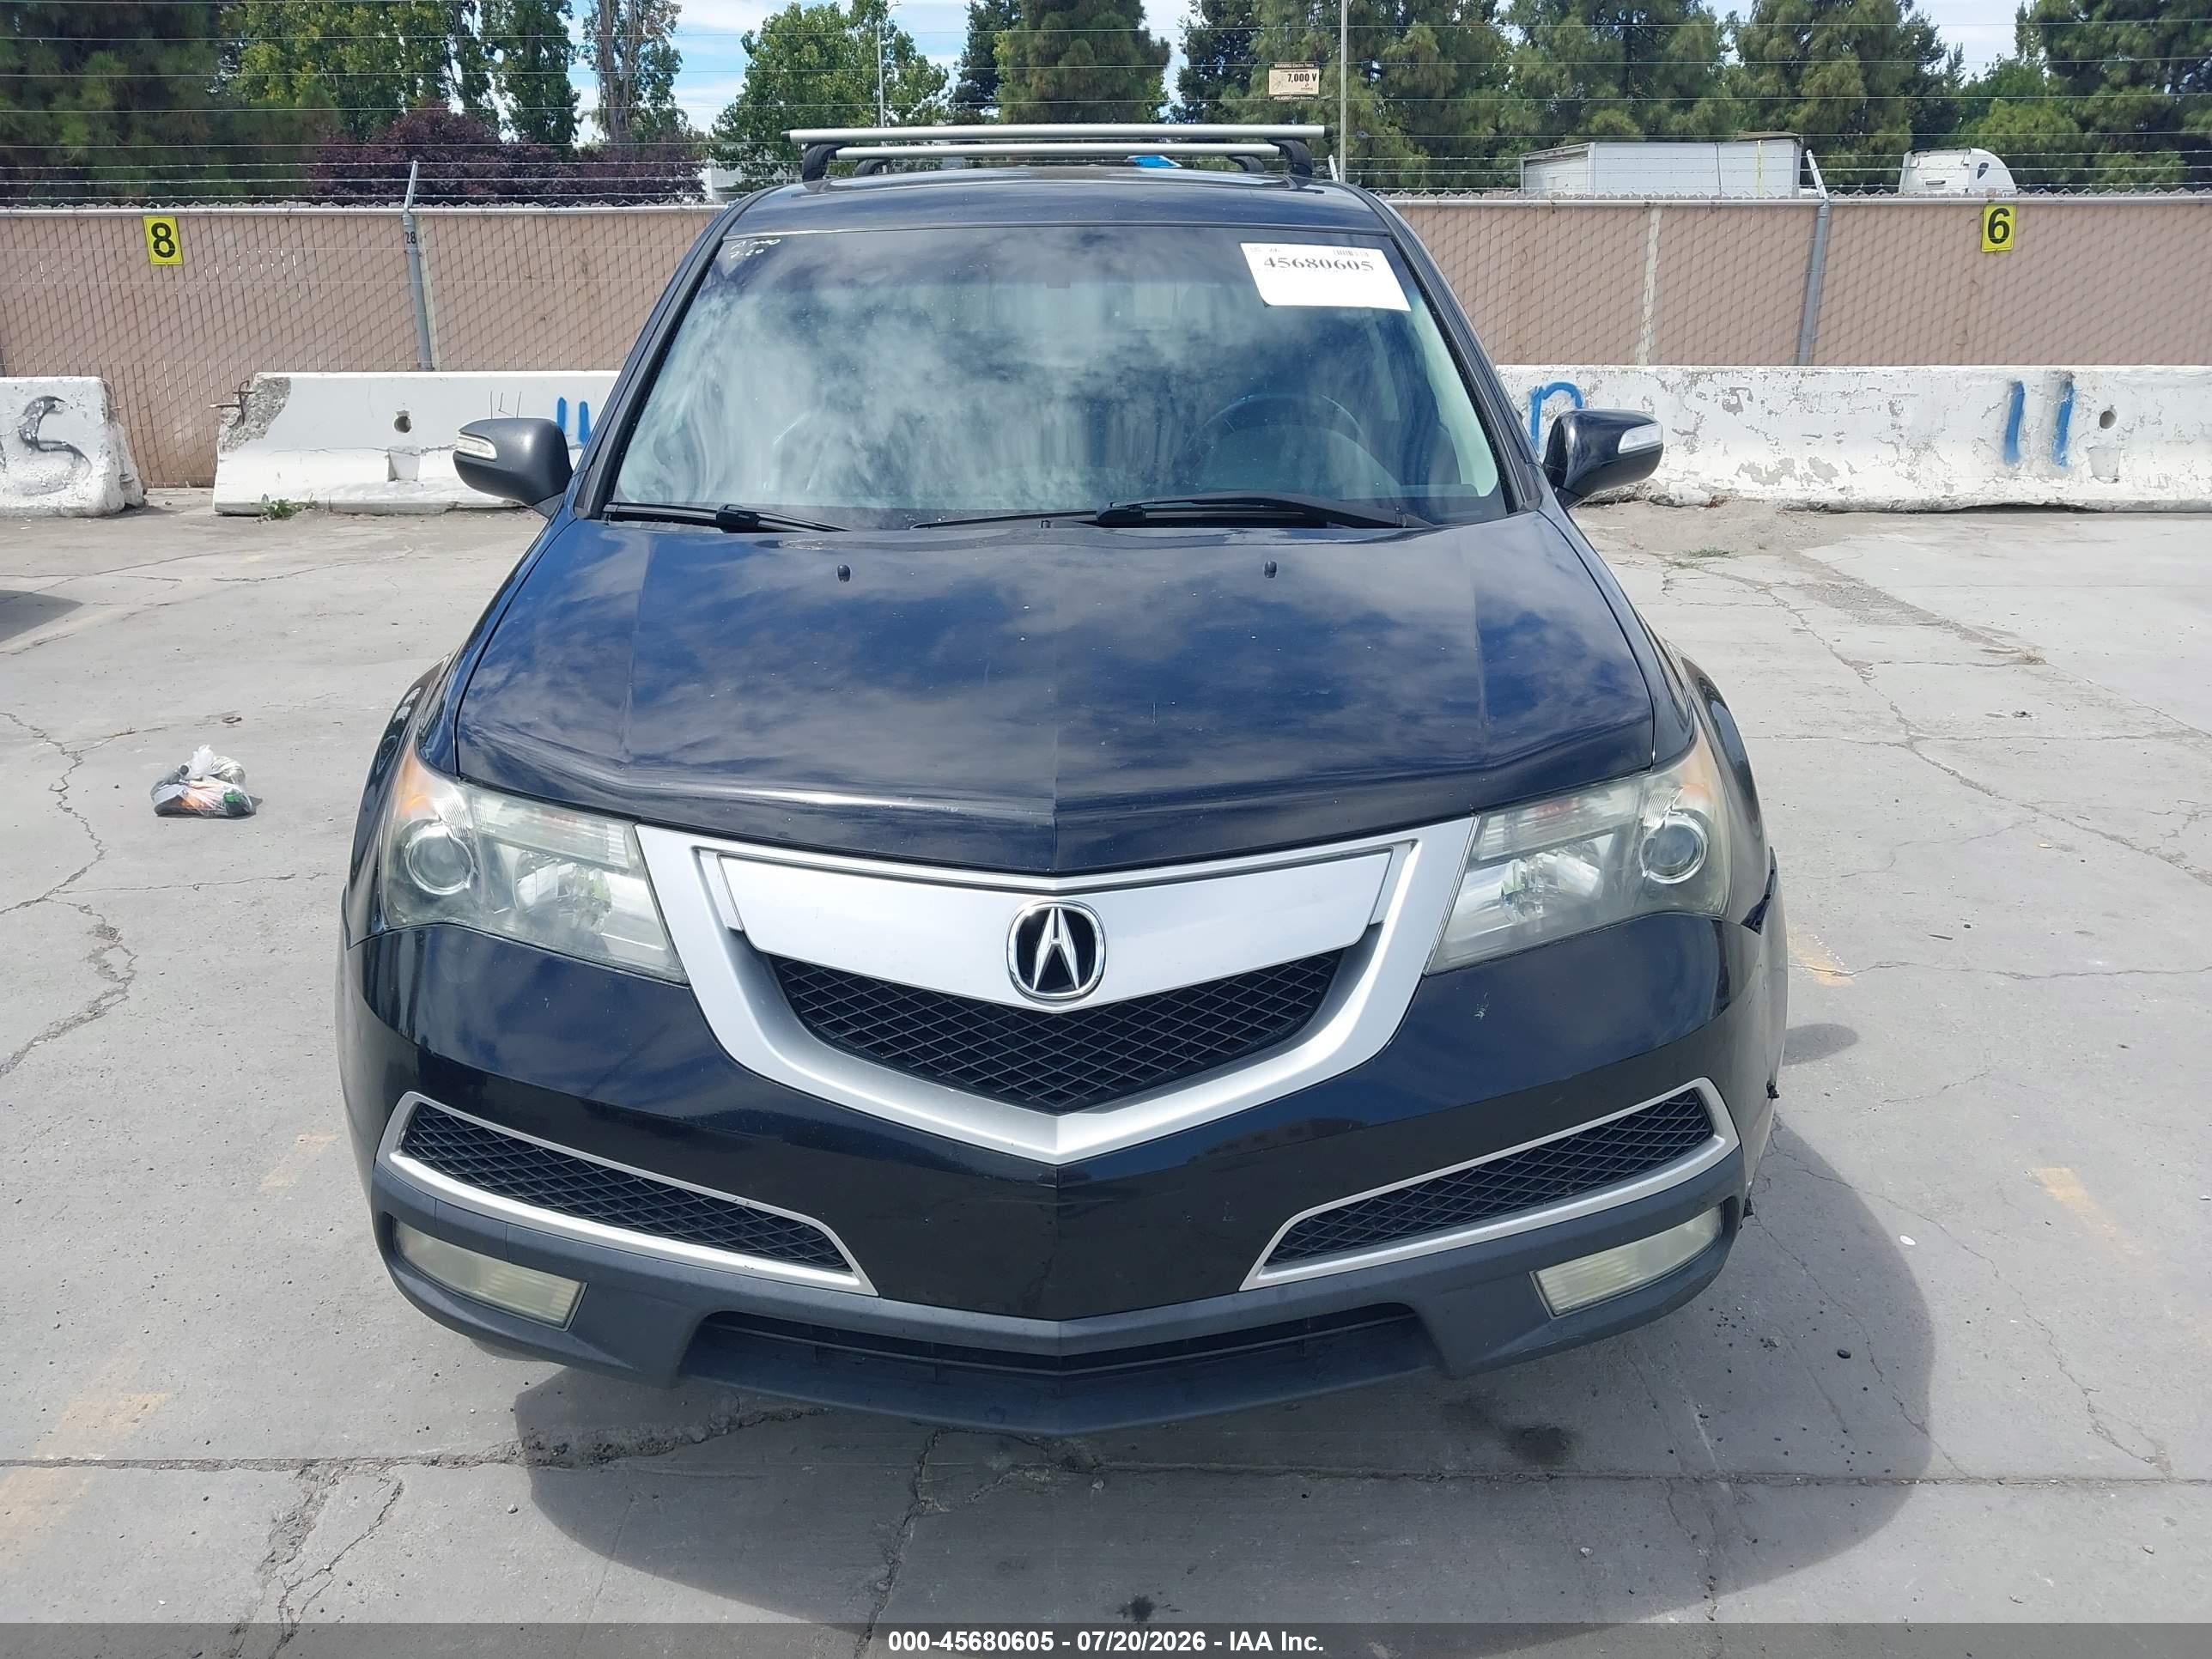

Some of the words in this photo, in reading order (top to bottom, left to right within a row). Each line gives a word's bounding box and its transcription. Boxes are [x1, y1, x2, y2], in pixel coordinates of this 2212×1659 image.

[1287, 73, 1310, 83] 7,000
[1311, 73, 1317, 82] V
[1988, 208, 2010, 244] 6
[151, 222, 175, 258] 8
[404, 231, 416, 245] 28
[1264, 257, 1374, 271] 45680605
